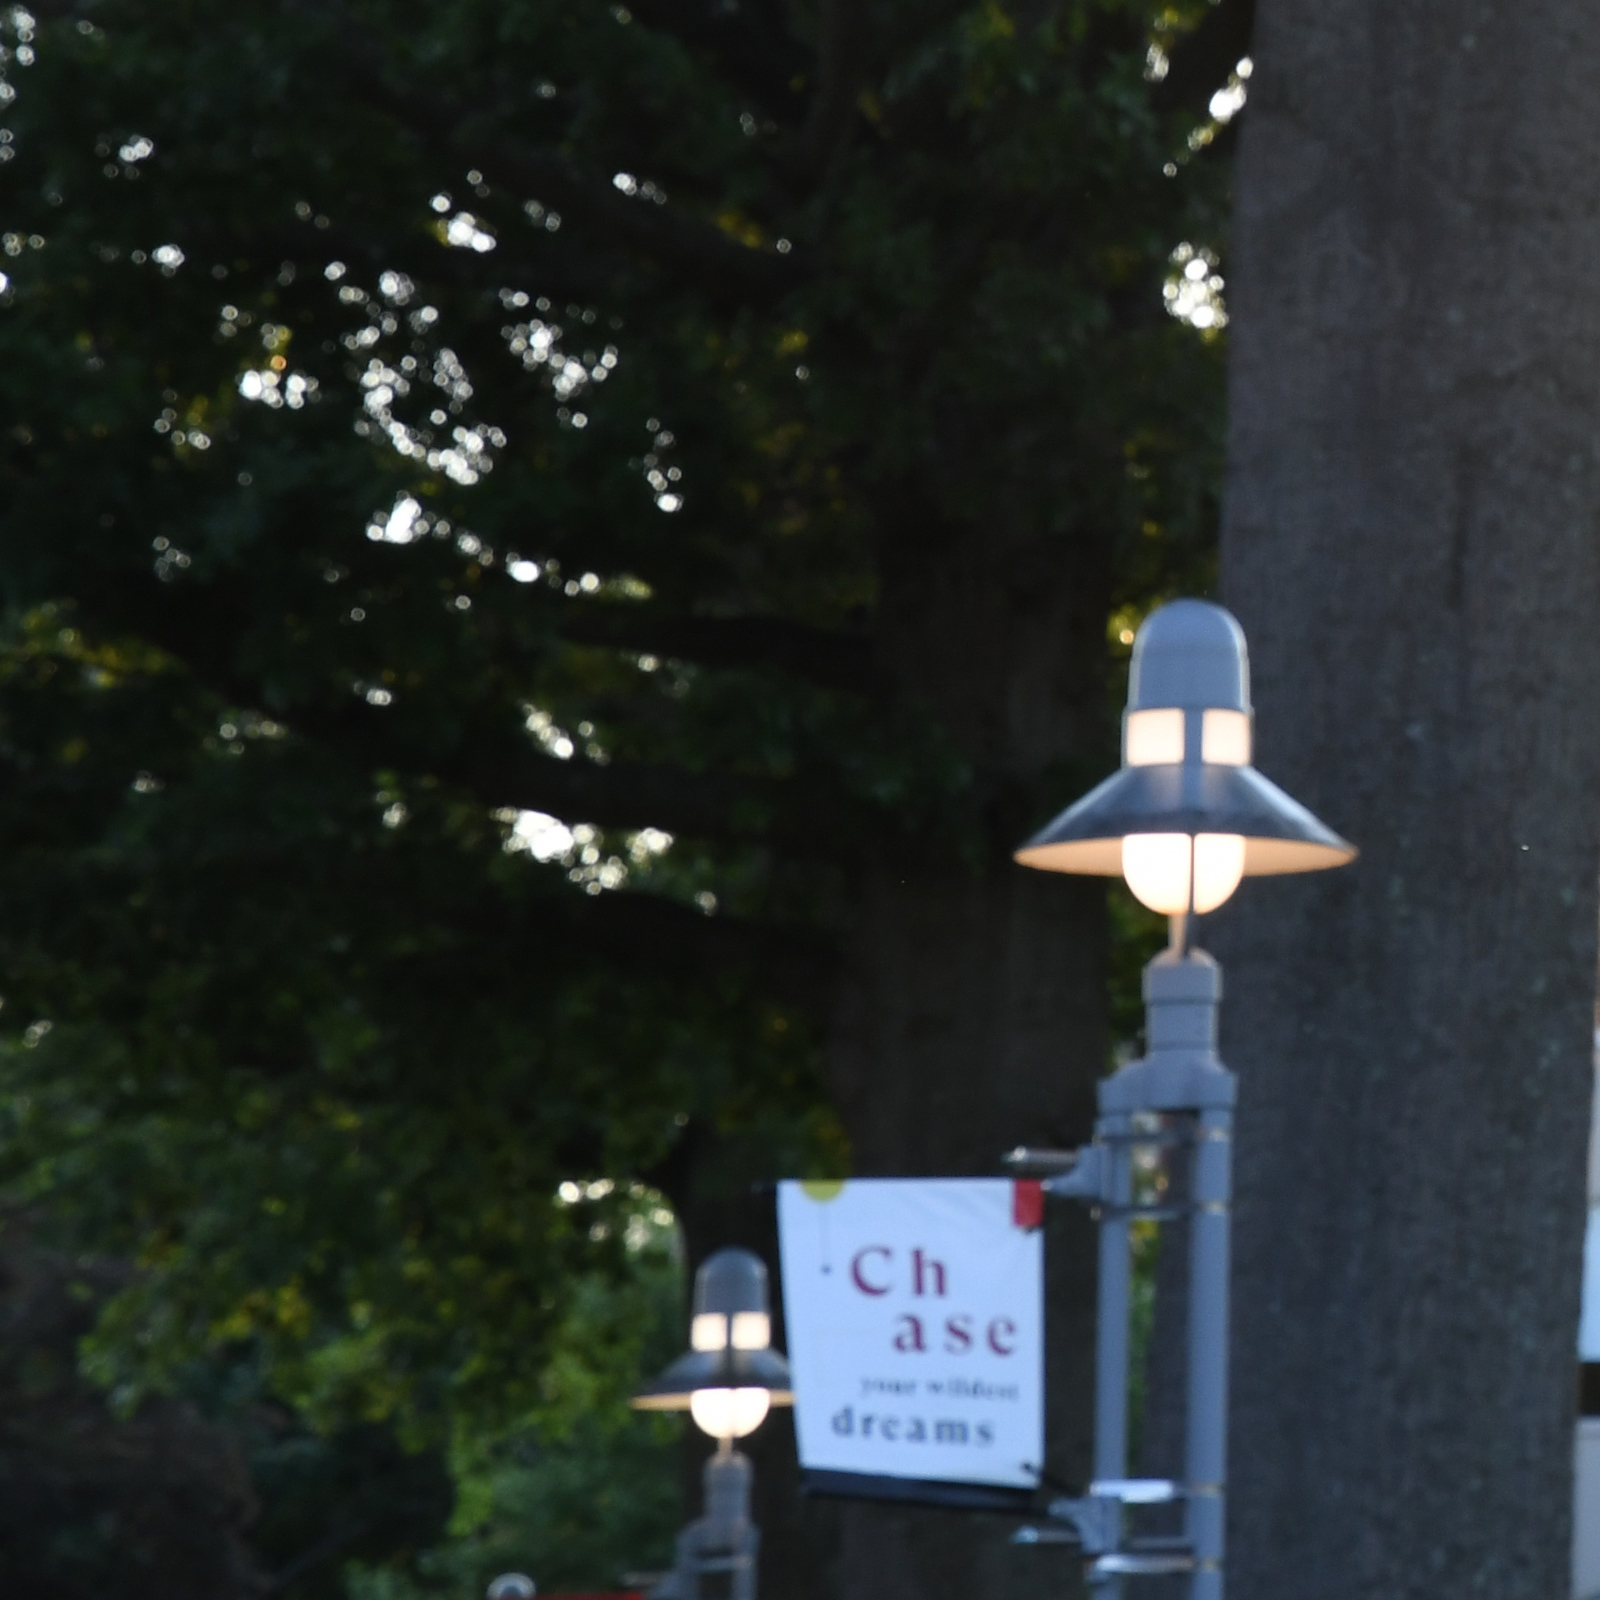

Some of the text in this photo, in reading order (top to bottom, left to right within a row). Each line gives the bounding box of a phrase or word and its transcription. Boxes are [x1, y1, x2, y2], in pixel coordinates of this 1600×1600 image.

[849, 1245, 947, 1297] Ch
[893, 1311, 1018, 1357] ase
[830, 1404, 996, 1447] dreams
